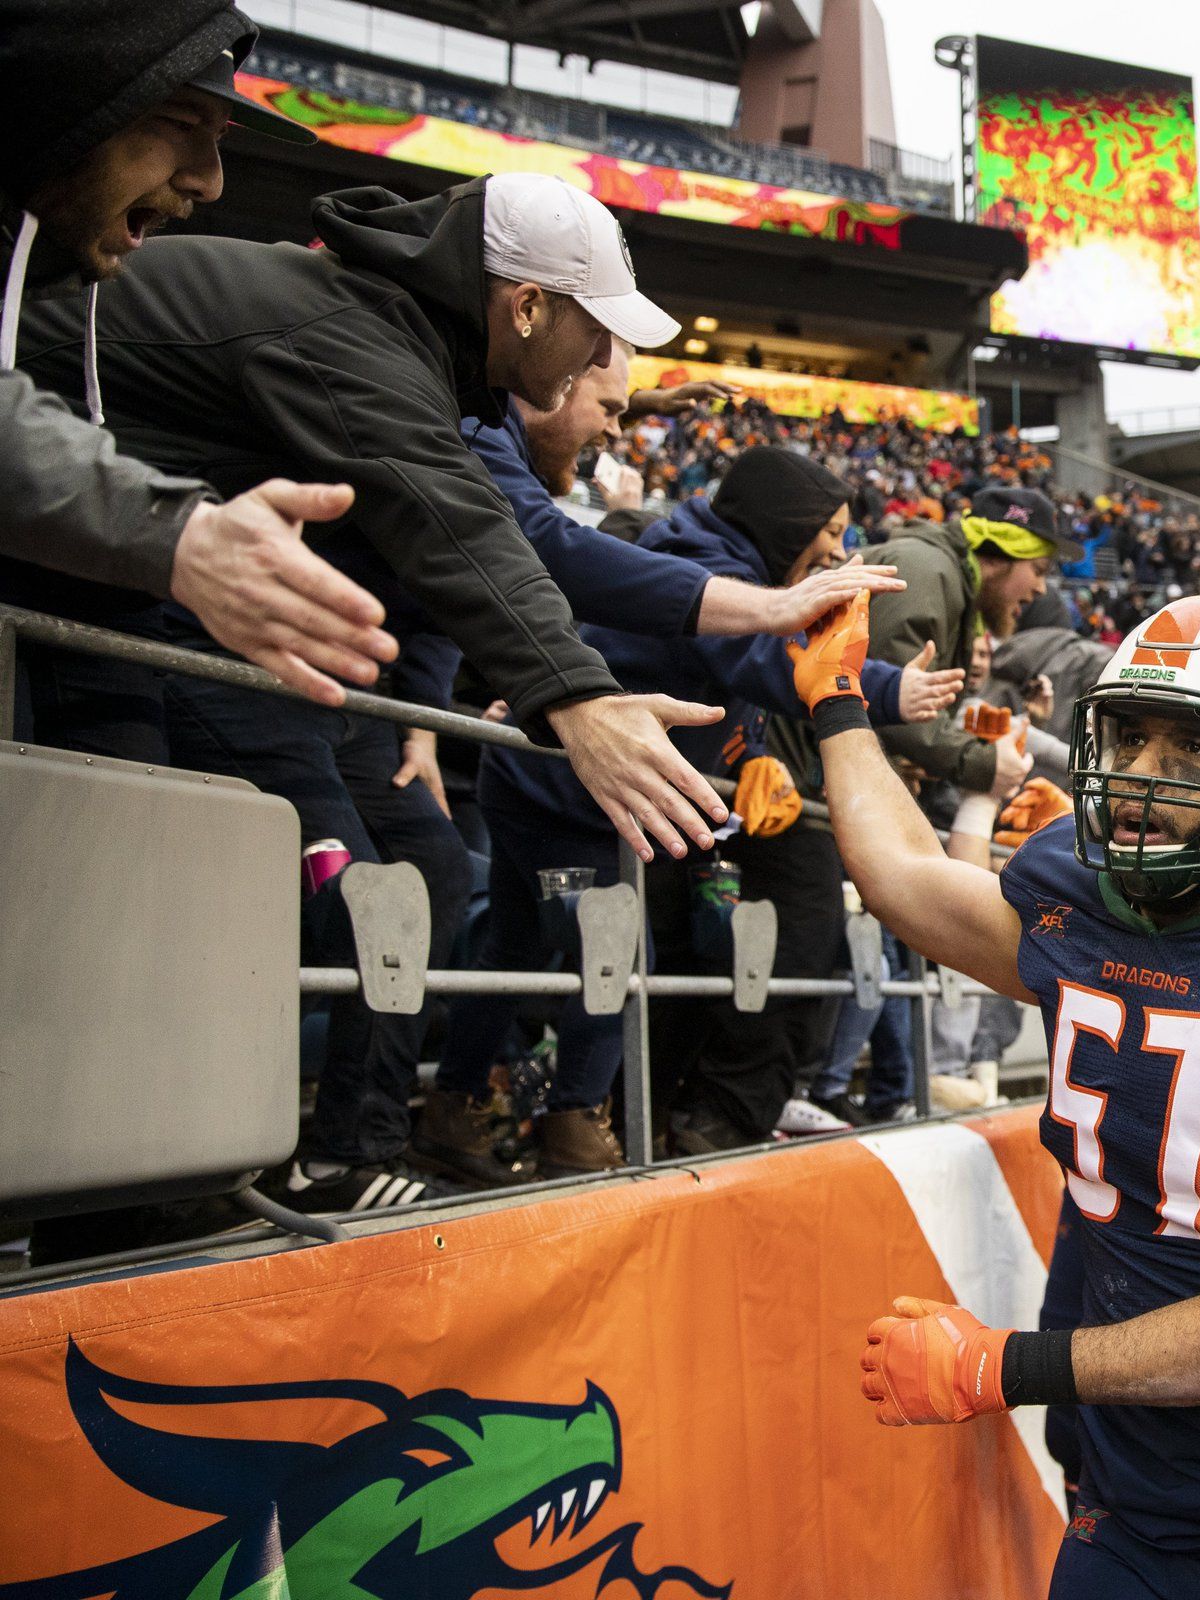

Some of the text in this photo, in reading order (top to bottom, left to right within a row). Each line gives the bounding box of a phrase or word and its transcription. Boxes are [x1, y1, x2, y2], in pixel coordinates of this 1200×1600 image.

[1118, 668, 1176, 682] DRAGONS
[1101, 960, 1191, 996] DRAGONS
[976, 1351, 987, 1396] CUTTERS
